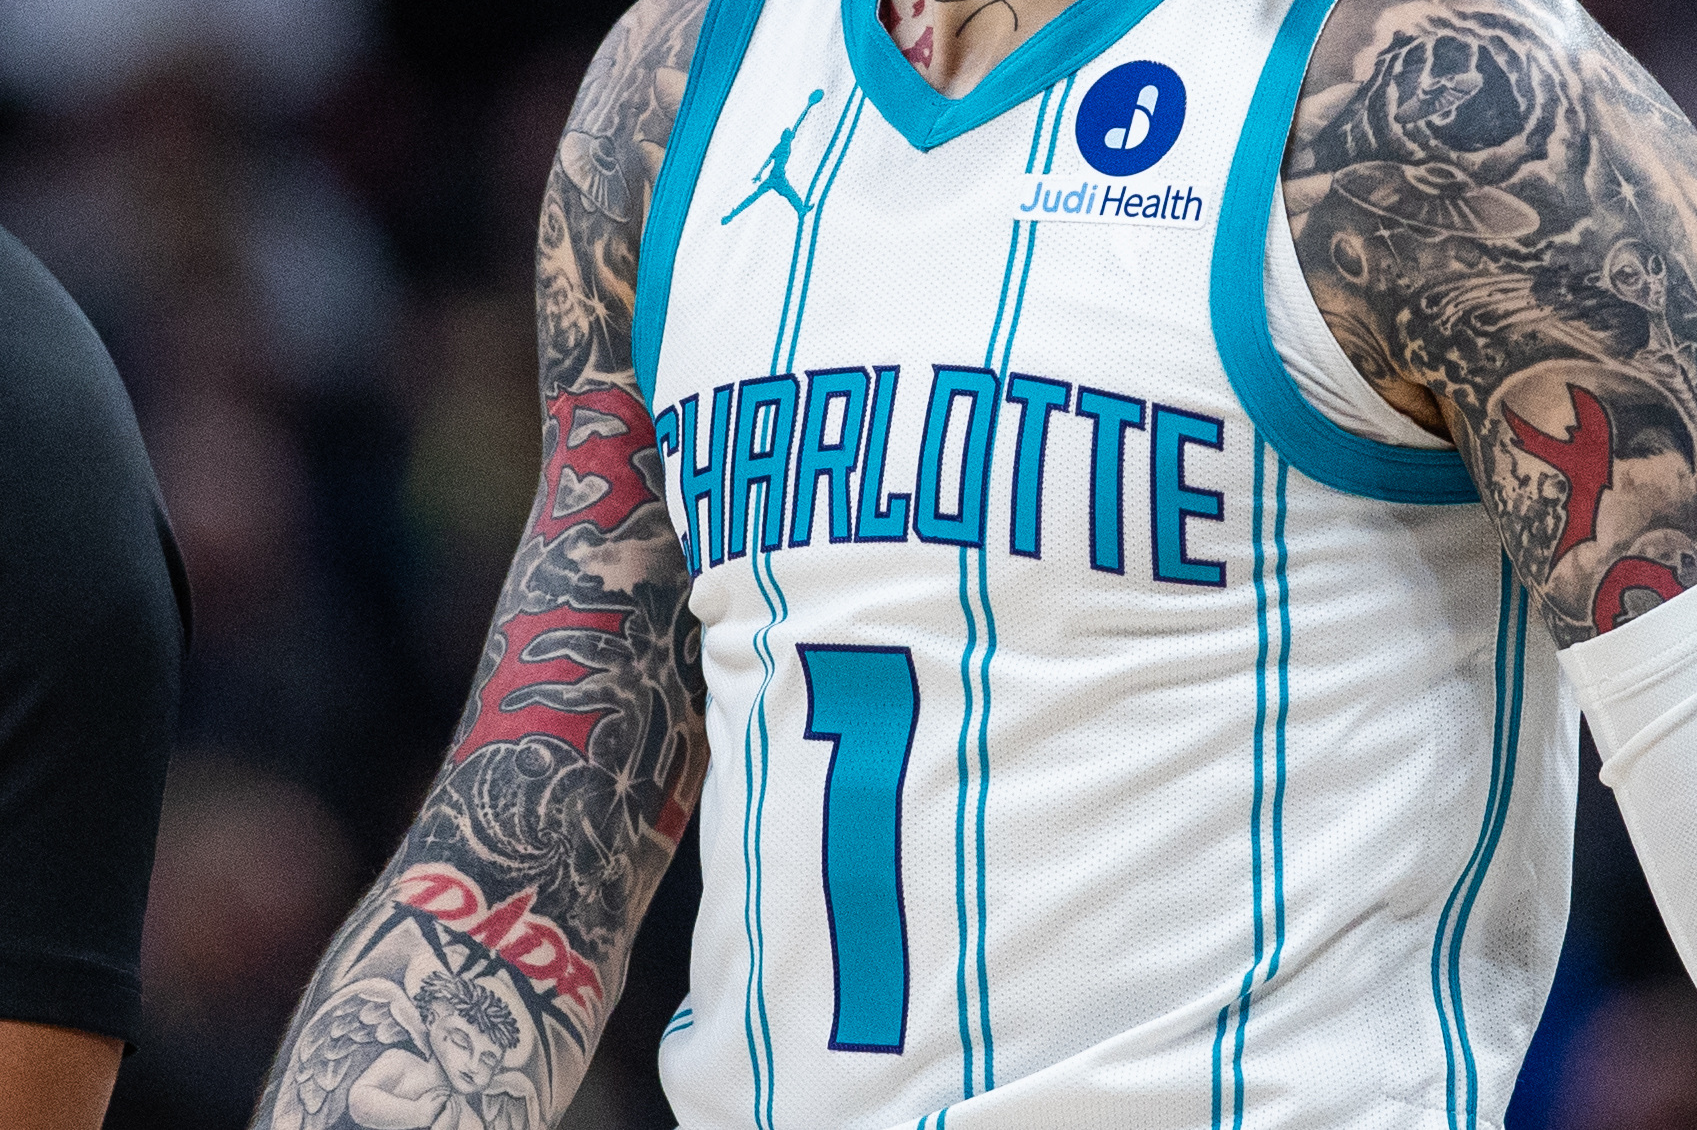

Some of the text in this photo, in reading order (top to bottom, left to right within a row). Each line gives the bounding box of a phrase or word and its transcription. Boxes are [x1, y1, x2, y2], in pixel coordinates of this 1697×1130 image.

[1020, 182, 1203, 221] Judi Health
[655, 364, 1227, 587] CHARLOTTE
[796, 643, 921, 1054] 1
